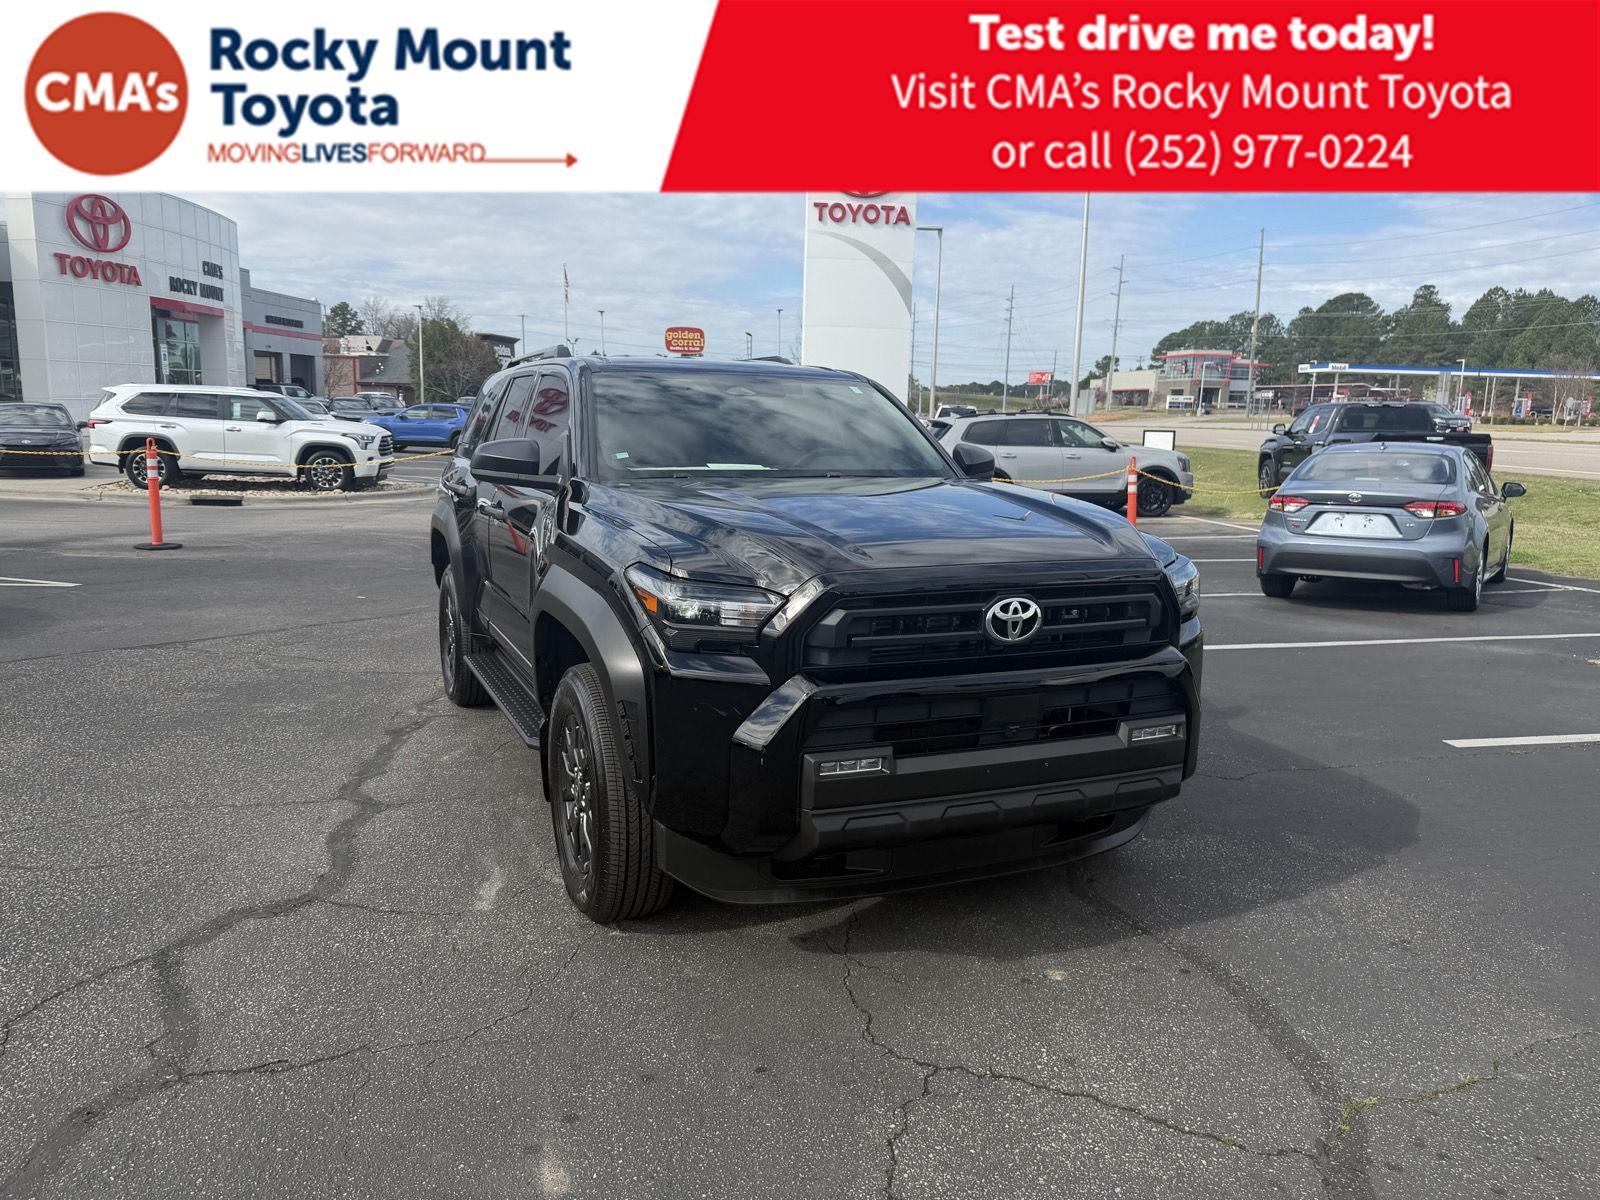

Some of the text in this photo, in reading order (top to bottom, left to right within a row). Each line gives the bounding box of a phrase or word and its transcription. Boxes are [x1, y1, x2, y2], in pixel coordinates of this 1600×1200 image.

[813, 202, 910, 225] TOYOTA
[53, 252, 142, 286] TOYOTA
[169, 275, 224, 302] ROCKY MOUNT
[666, 331, 700, 340] golden
[671, 339, 704, 347] corral
